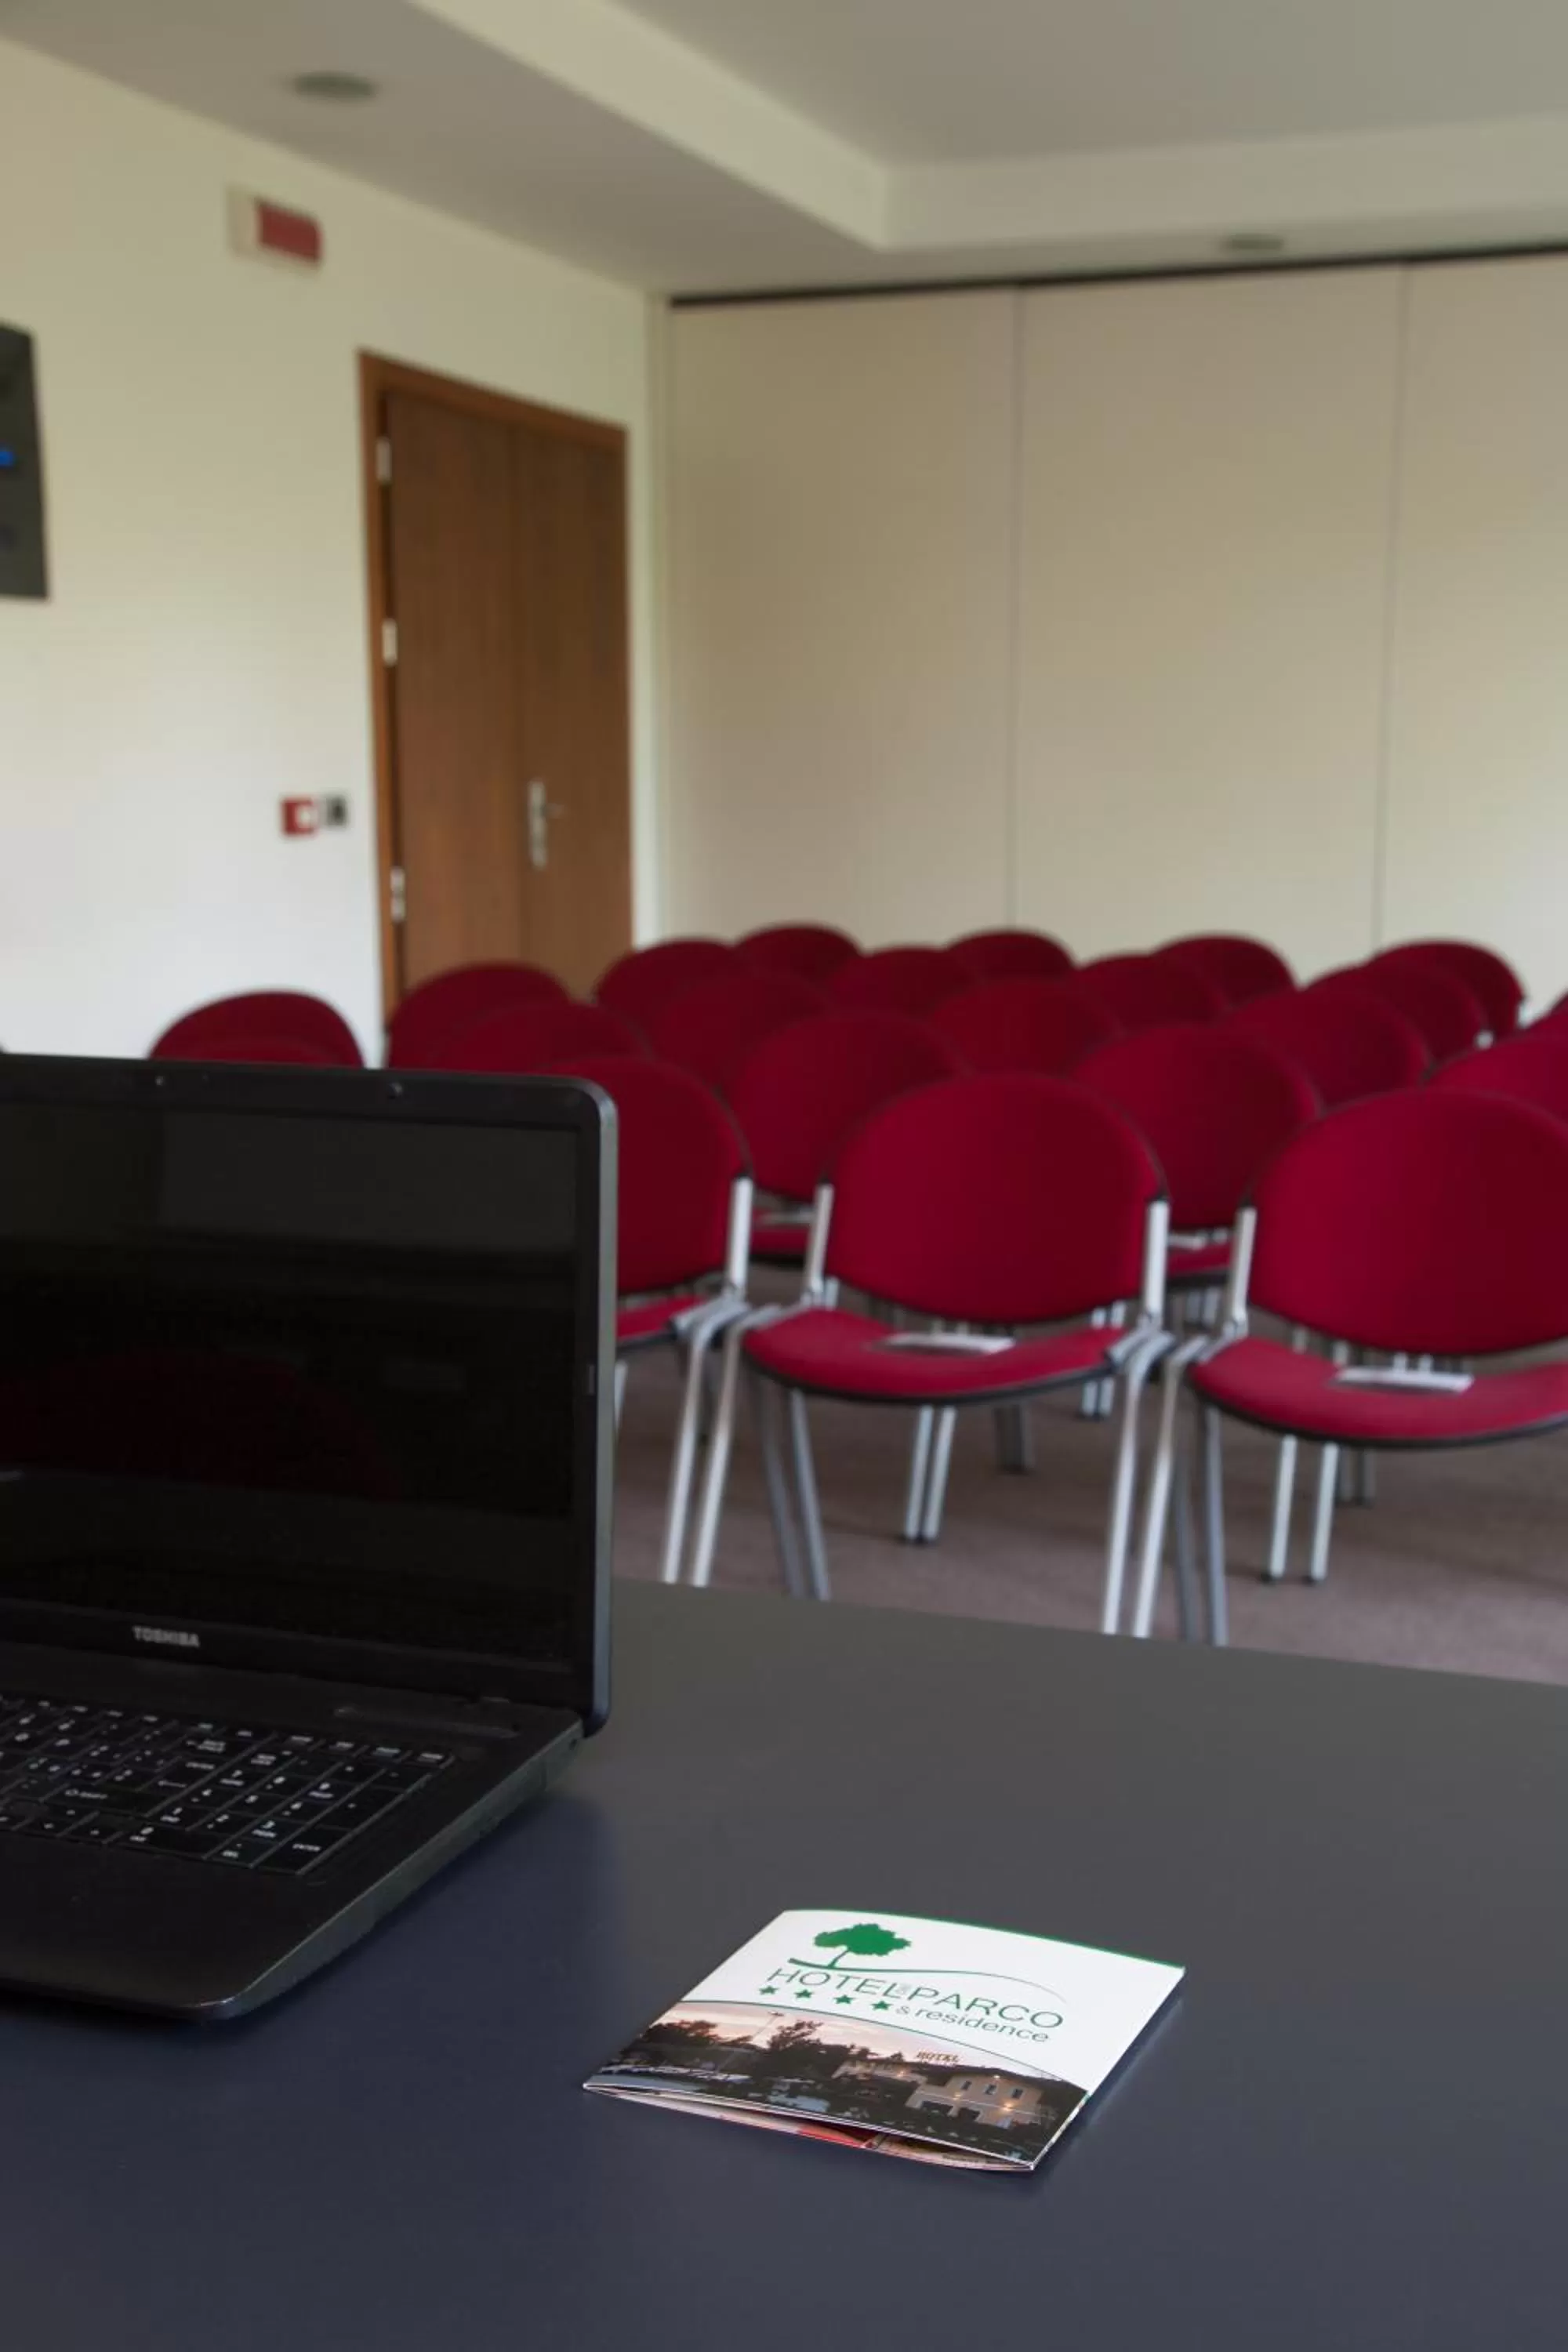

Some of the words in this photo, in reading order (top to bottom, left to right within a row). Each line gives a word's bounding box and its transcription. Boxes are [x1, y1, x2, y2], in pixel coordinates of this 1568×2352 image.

[132, 1625, 200, 1647] TOSHIBA
[768, 1968, 901, 1998] HOTEL
[907, 1986, 1063, 2028] PARCO
[915, 2006, 1048, 2042] residence
